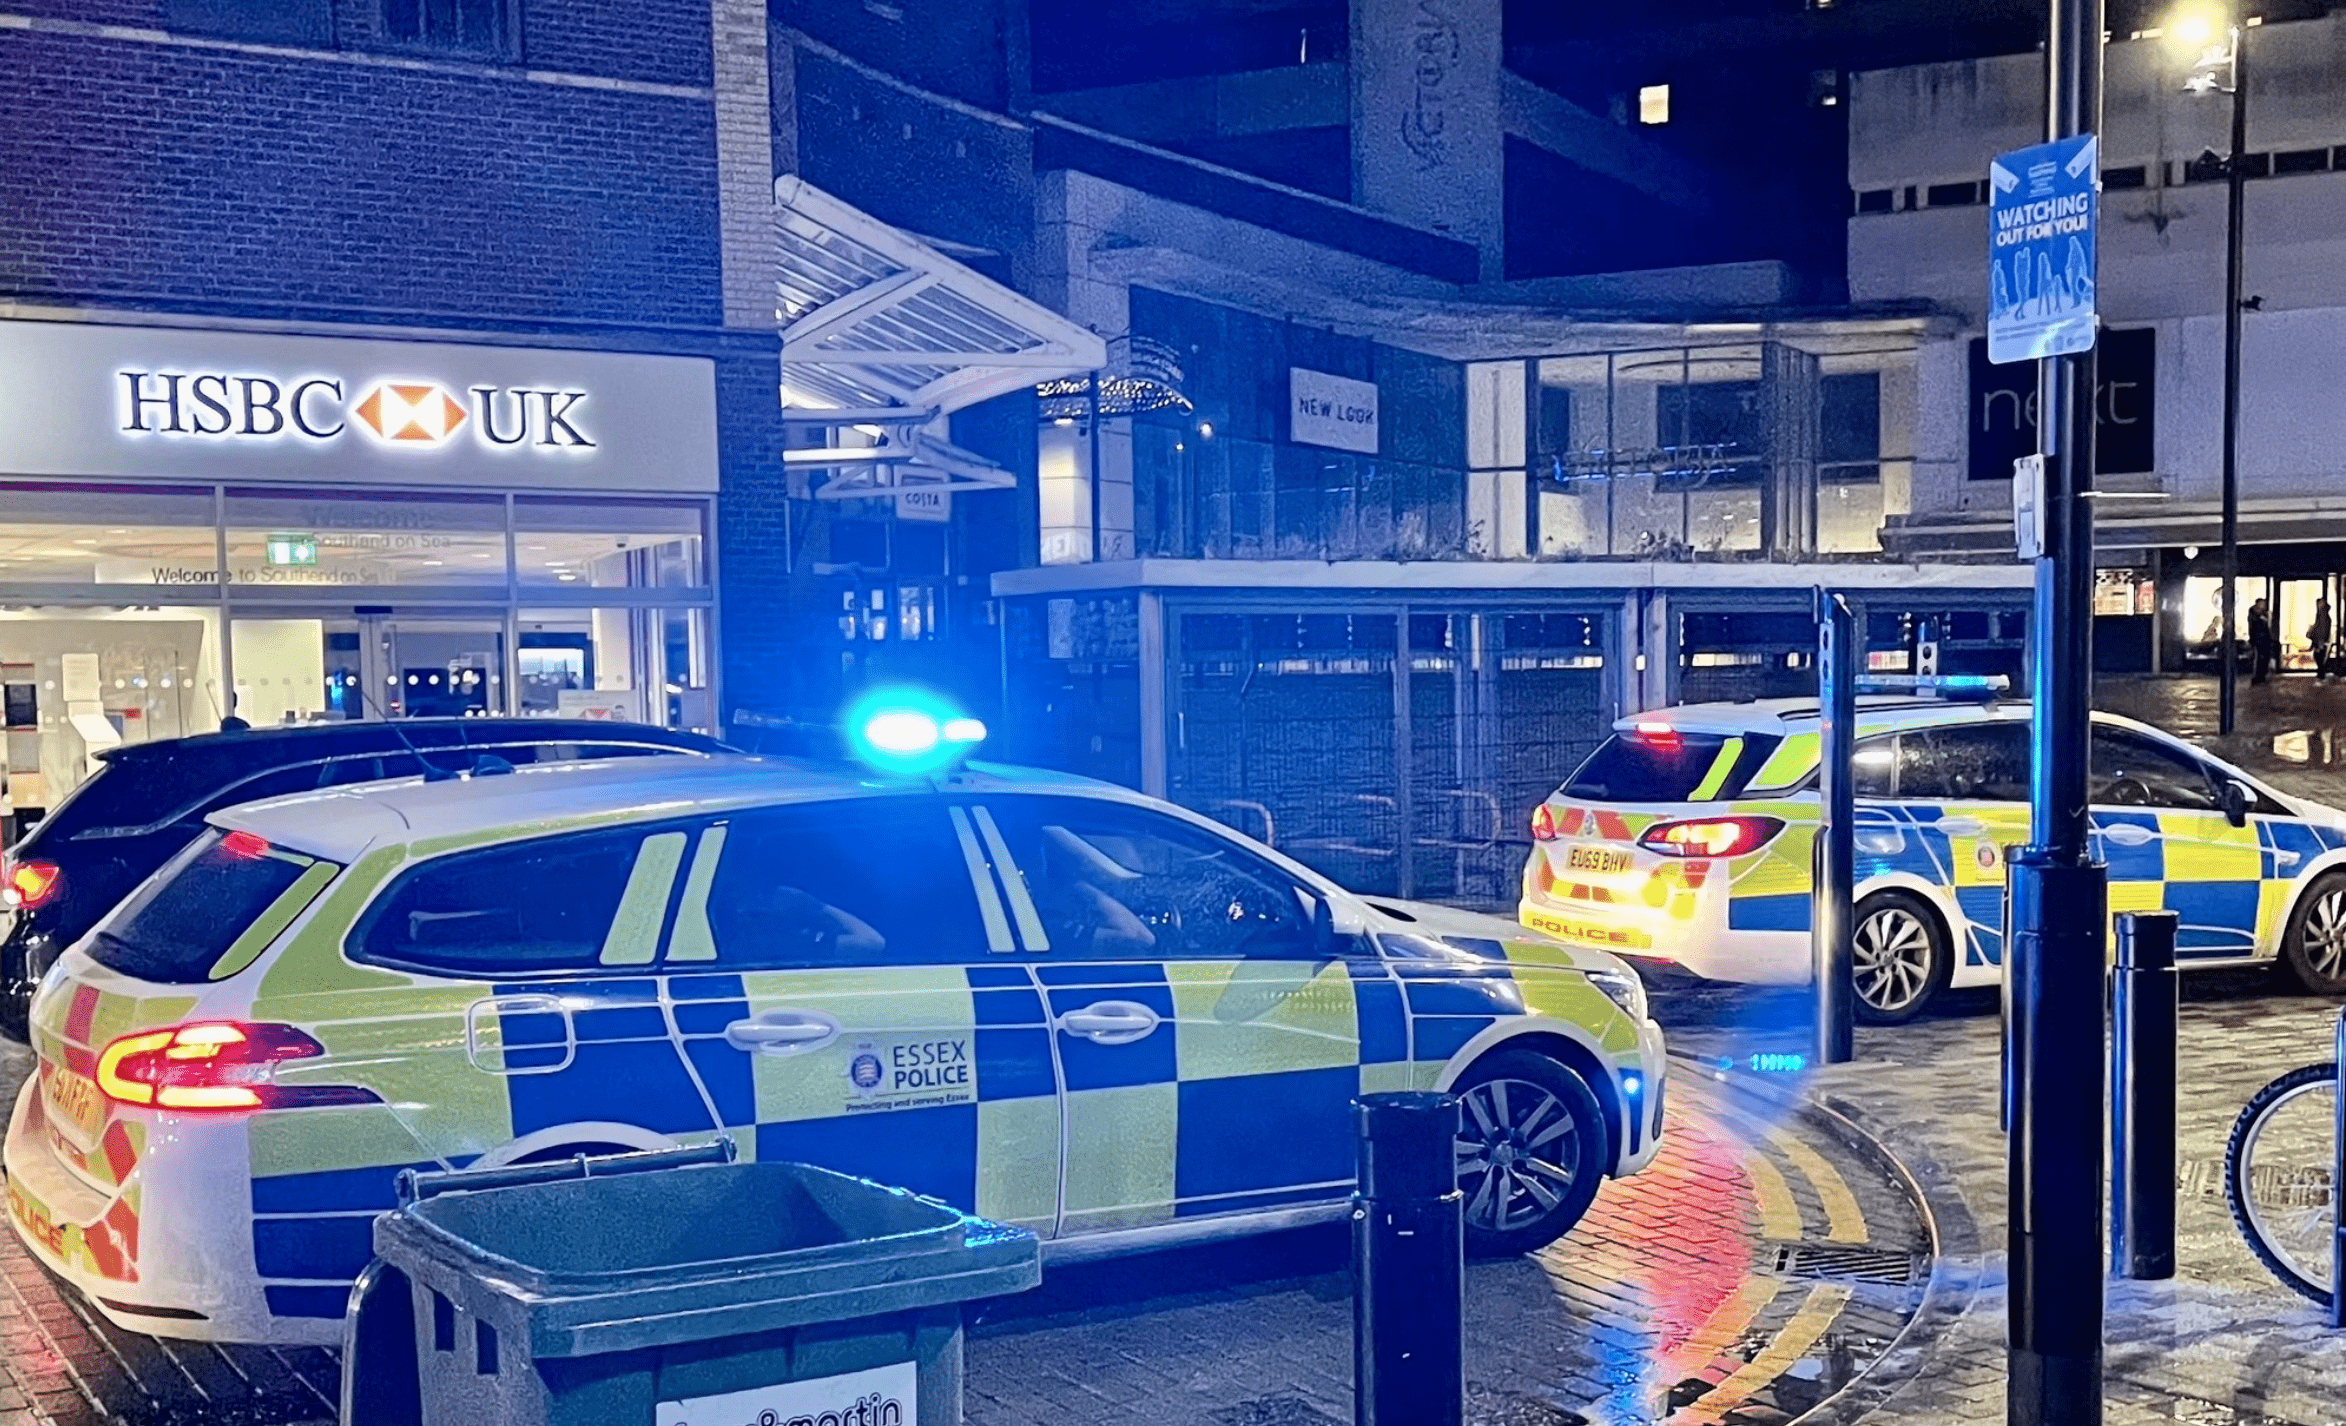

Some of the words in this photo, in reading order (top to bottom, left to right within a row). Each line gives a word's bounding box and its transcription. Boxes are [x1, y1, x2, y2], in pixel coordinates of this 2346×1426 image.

[1997, 192, 2088, 230] WATCHING
[1996, 227, 2025, 246] OUT
[2026, 221, 2053, 241] FOR
[119, 371, 345, 439] HSBC
[470, 388, 597, 447] UK
[1299, 396, 1332, 417] NEW
[1337, 404, 1374, 425] LOOK
[1983, 380, 2138, 432] nt
[905, 492, 940, 507] COSTA
[239, 569, 256, 583] to
[1570, 848, 1601, 870] EU69
[1602, 852, 1627, 872] BHV
[1532, 918, 1628, 942] POLICE
[893, 1040, 966, 1067] ESSEX
[894, 1065, 969, 1089] POLICE
